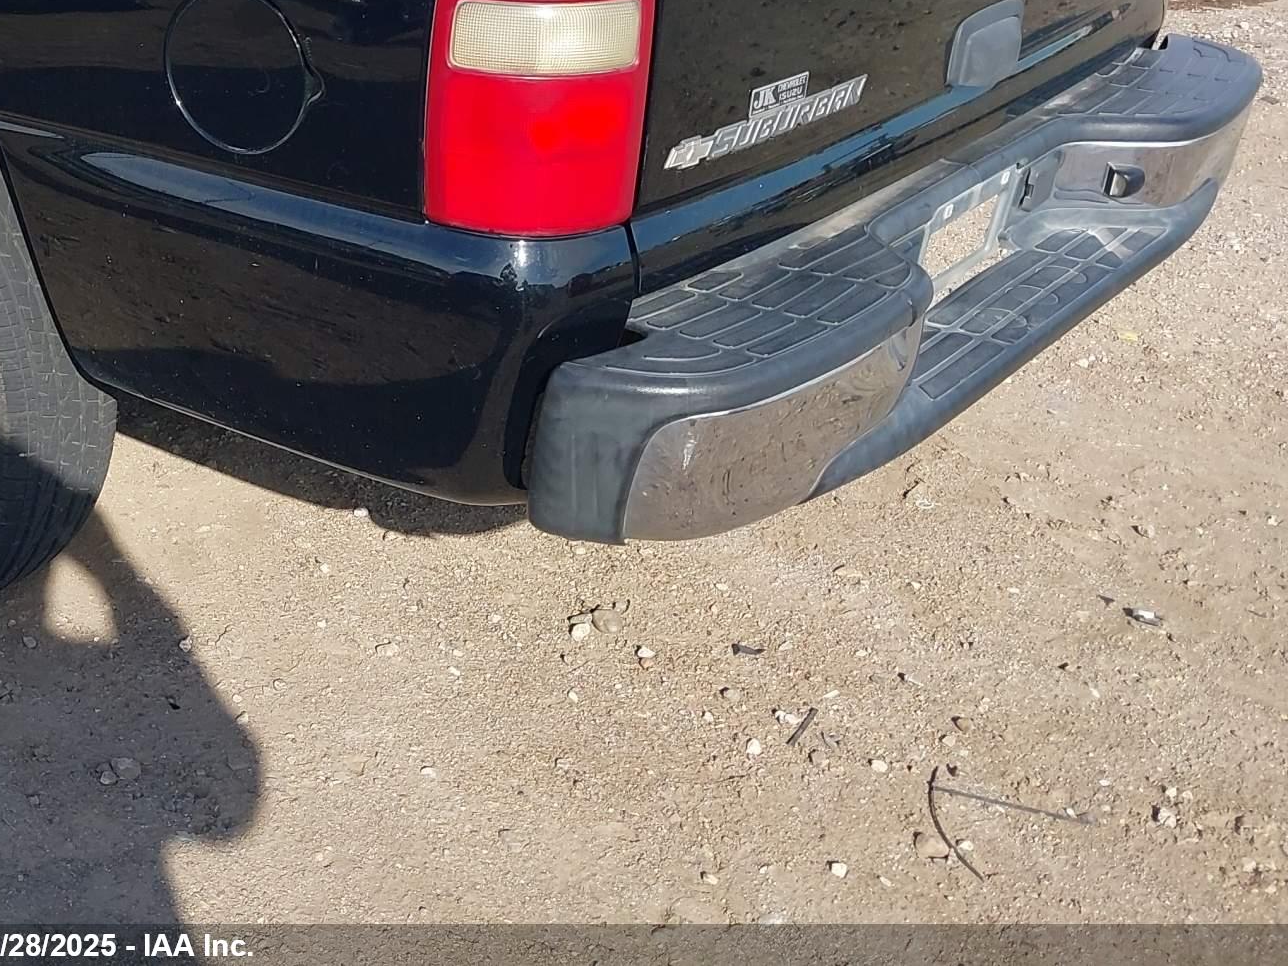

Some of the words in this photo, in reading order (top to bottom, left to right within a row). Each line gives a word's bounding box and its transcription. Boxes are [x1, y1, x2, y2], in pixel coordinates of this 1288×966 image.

[753, 86, 776, 110] JK
[778, 85, 803, 101] ISUZU
[712, 74, 868, 159] SUBURBAN
